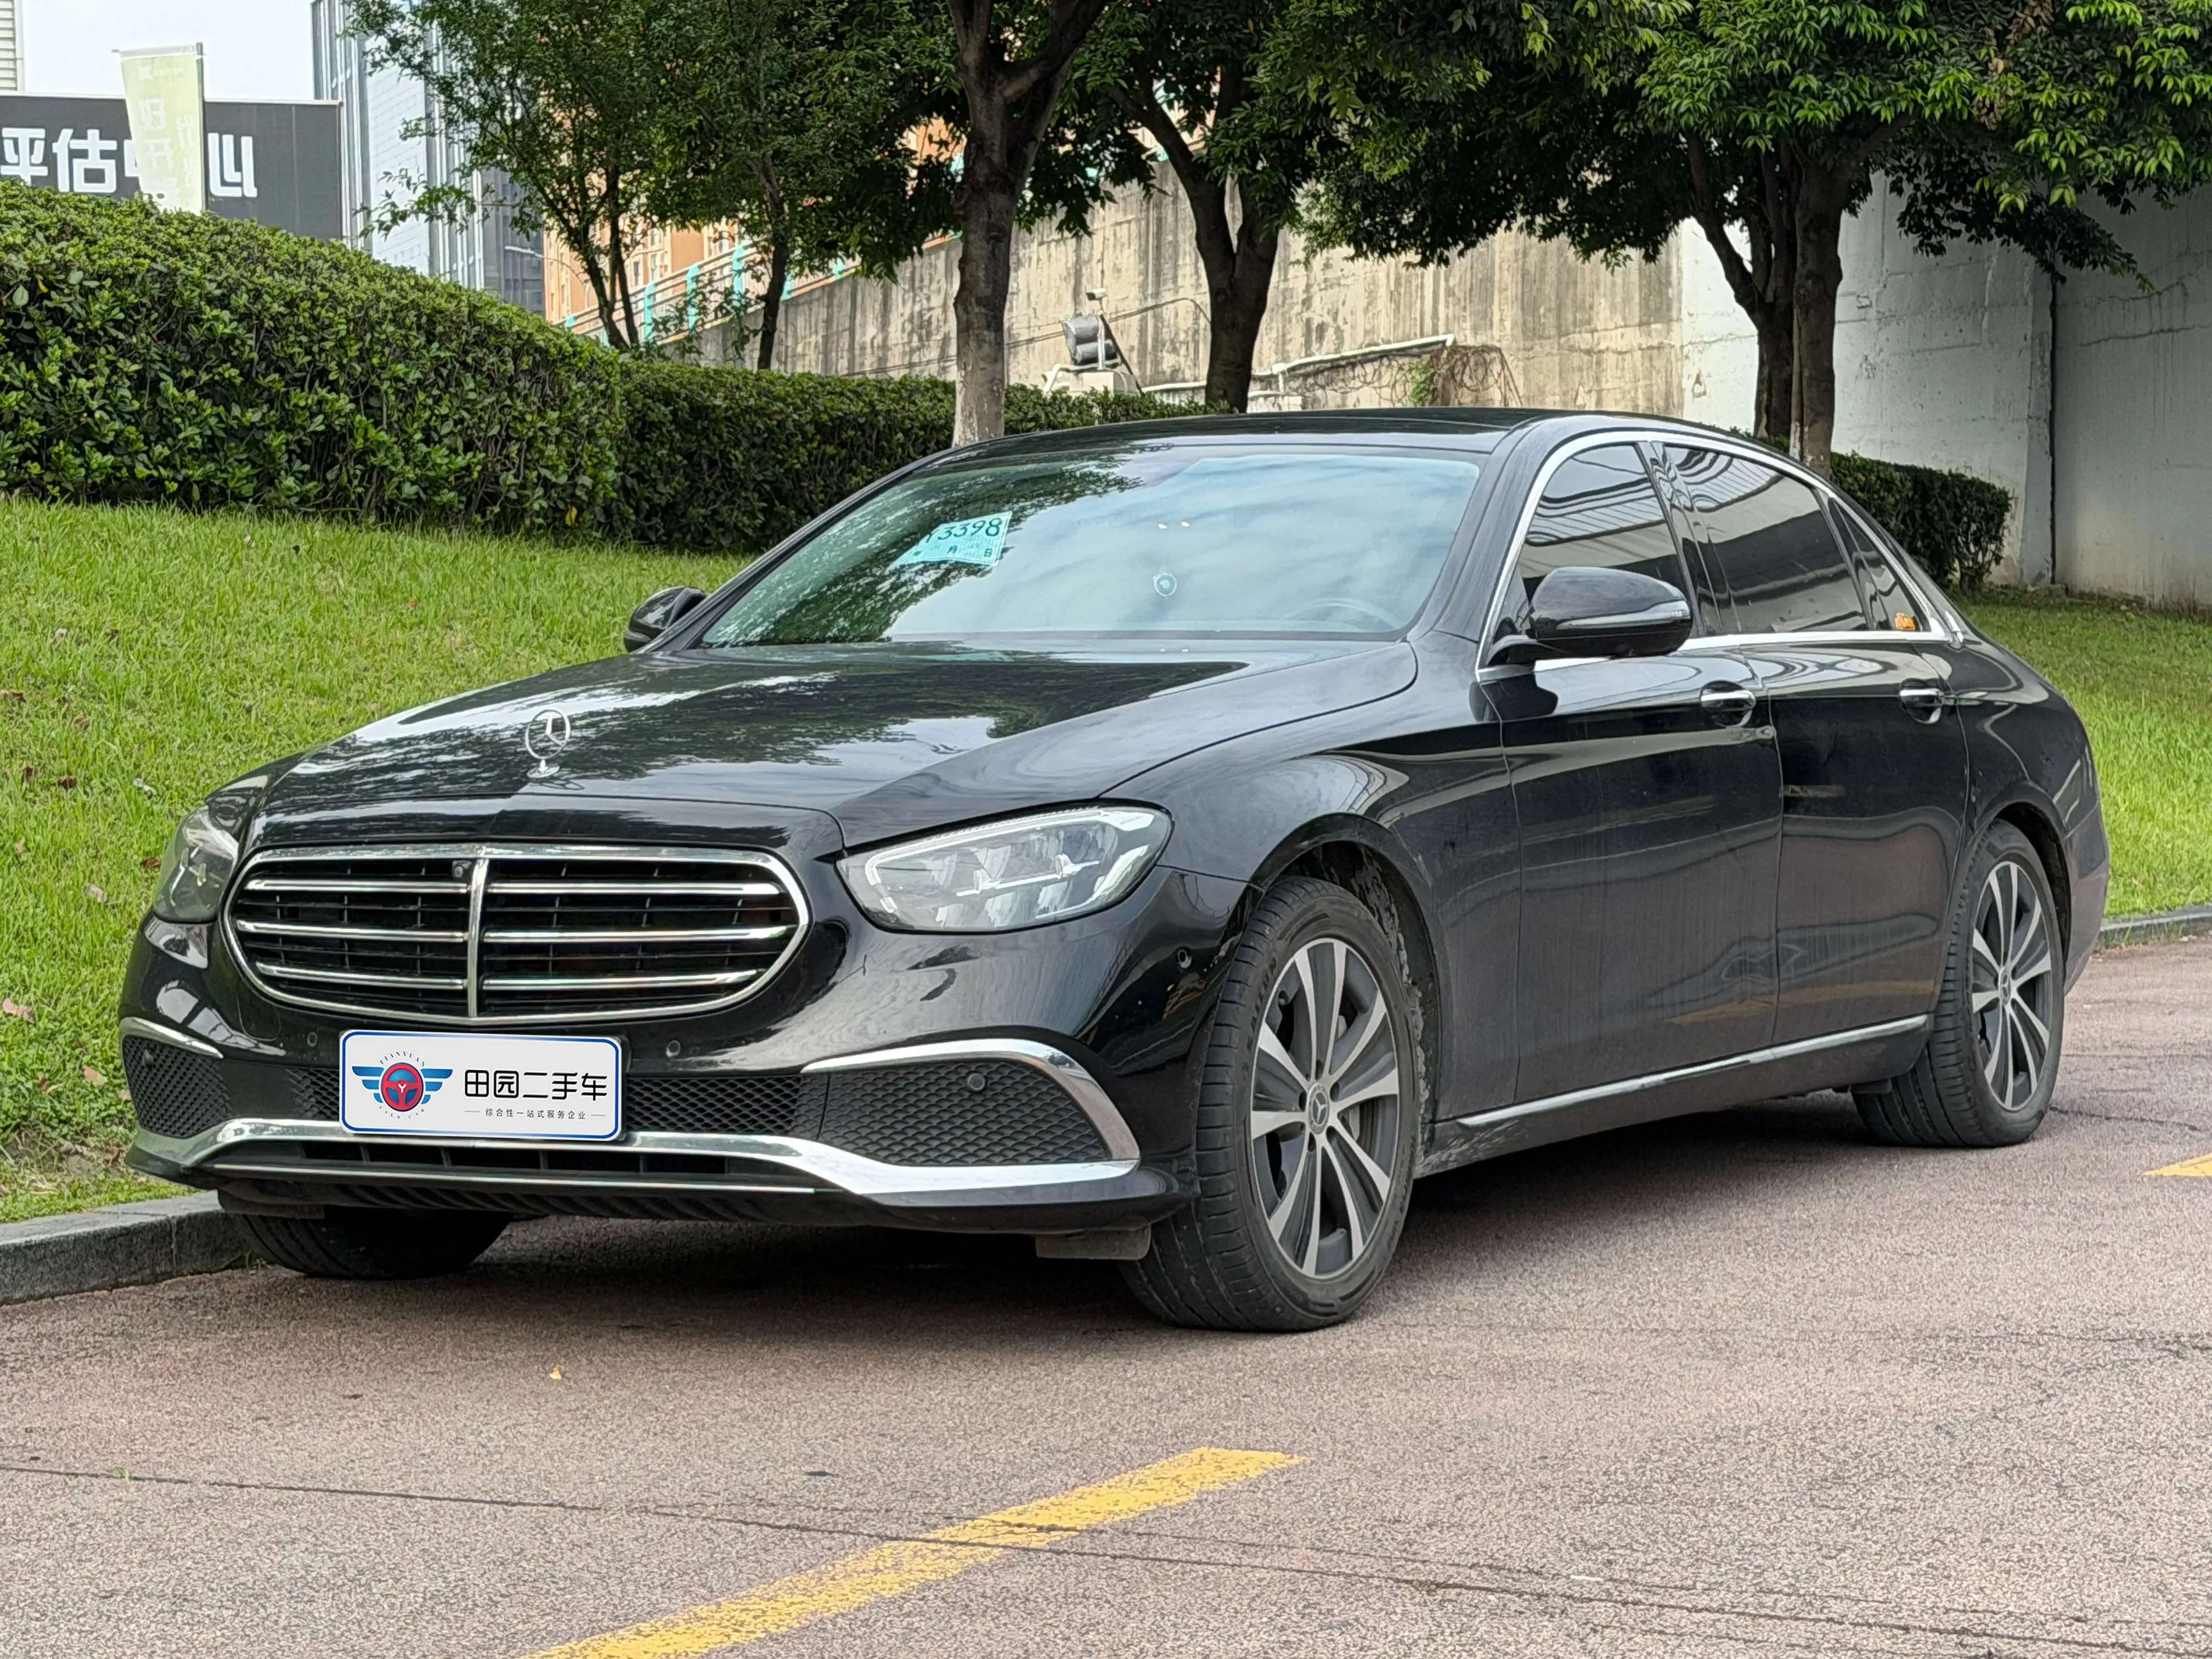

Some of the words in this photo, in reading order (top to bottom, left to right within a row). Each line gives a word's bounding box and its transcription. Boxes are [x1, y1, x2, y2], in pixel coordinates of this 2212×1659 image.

[465, 1069, 607, 1101] 田园二手车
[486, 1108, 586, 1120] 综合性一站式服务企业
